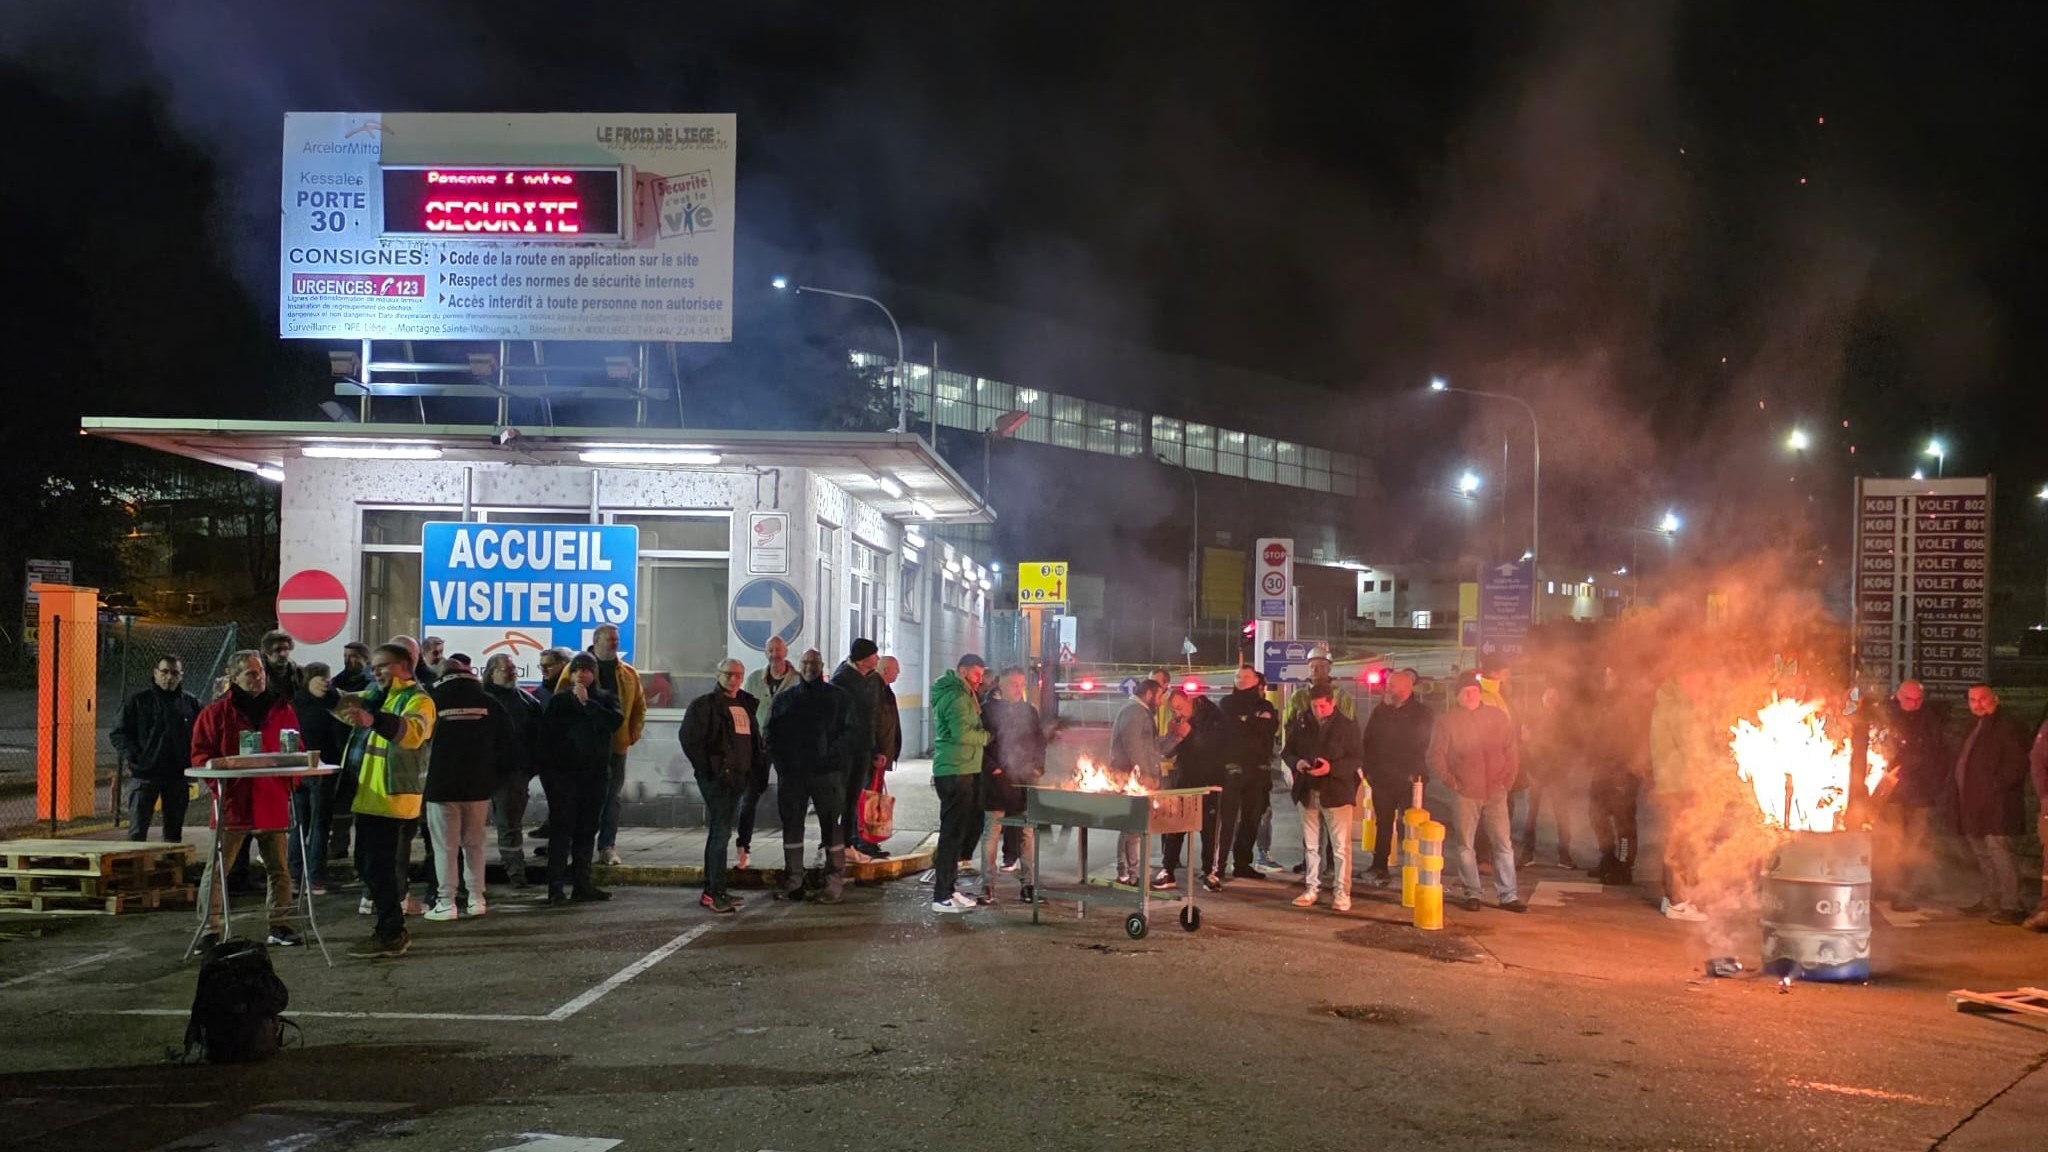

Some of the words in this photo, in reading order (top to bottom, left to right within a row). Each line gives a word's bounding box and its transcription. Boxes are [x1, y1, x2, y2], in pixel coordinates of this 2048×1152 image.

[596, 126, 613, 143] LE
[615, 126, 654, 143] FROID
[657, 126, 673, 143] DE
[658, 173, 709, 197] Sécurité
[297, 191, 366, 209] PORTE
[310, 211, 346, 232] 30
[289, 248, 429, 265] CONSIGNES:
[449, 251, 480, 265] Code
[483, 251, 498, 265] de
[501, 252, 512, 265] la
[515, 254, 547, 266] route
[551, 256, 566, 266] en
[569, 252, 636, 269] application
[639, 256, 658, 267] sur
[662, 253, 673, 267] le
[676, 253, 699, 267] site
[396, 281, 419, 294] 123
[449, 273, 499, 290] Respect
[501, 273, 522, 287] des
[526, 276, 570, 287] normes
[574, 273, 588, 287] de
[592, 273, 641, 288] sécurité
[645, 274, 695, 288] internes
[448, 294, 485, 308] Accès
[489, 294, 532, 309] interdit
[536, 295, 543, 309] à
[547, 296, 578, 309] toute
[582, 299, 637, 312] personne
[641, 300, 663, 310] non
[667, 297, 723, 311] autorisée
[288, 323, 336, 332] Surveillance
[1866, 500, 1894, 511] K08
[1918, 500, 1959, 511] VOLET
[1964, 500, 1985, 511] 802
[1918, 520, 1959, 531] VOLET
[1964, 520, 1985, 530] 801
[448, 529, 612, 571] ACCUEIL
[1917, 539, 1958, 550] VOLET
[1264, 551, 1286, 560] STOP
[1864, 558, 1893, 570] K06
[1917, 559, 1957, 570] VOLET
[1963, 559, 1985, 570] 605
[1267, 578, 1282, 589] 30
[1864, 578, 1893, 589] K06
[1916, 578, 1957, 589] VOLET
[1962, 578, 1984, 589] 604
[429, 581, 629, 624] VISITEURS
[1864, 601, 1891, 612] K02
[1916, 598, 1957, 609] VOLET
[1962, 598, 1984, 609] 205
[1919, 627, 1957, 638] OLET
[1920, 646, 1956, 658] OLET
[1919, 666, 1956, 678] OLET
